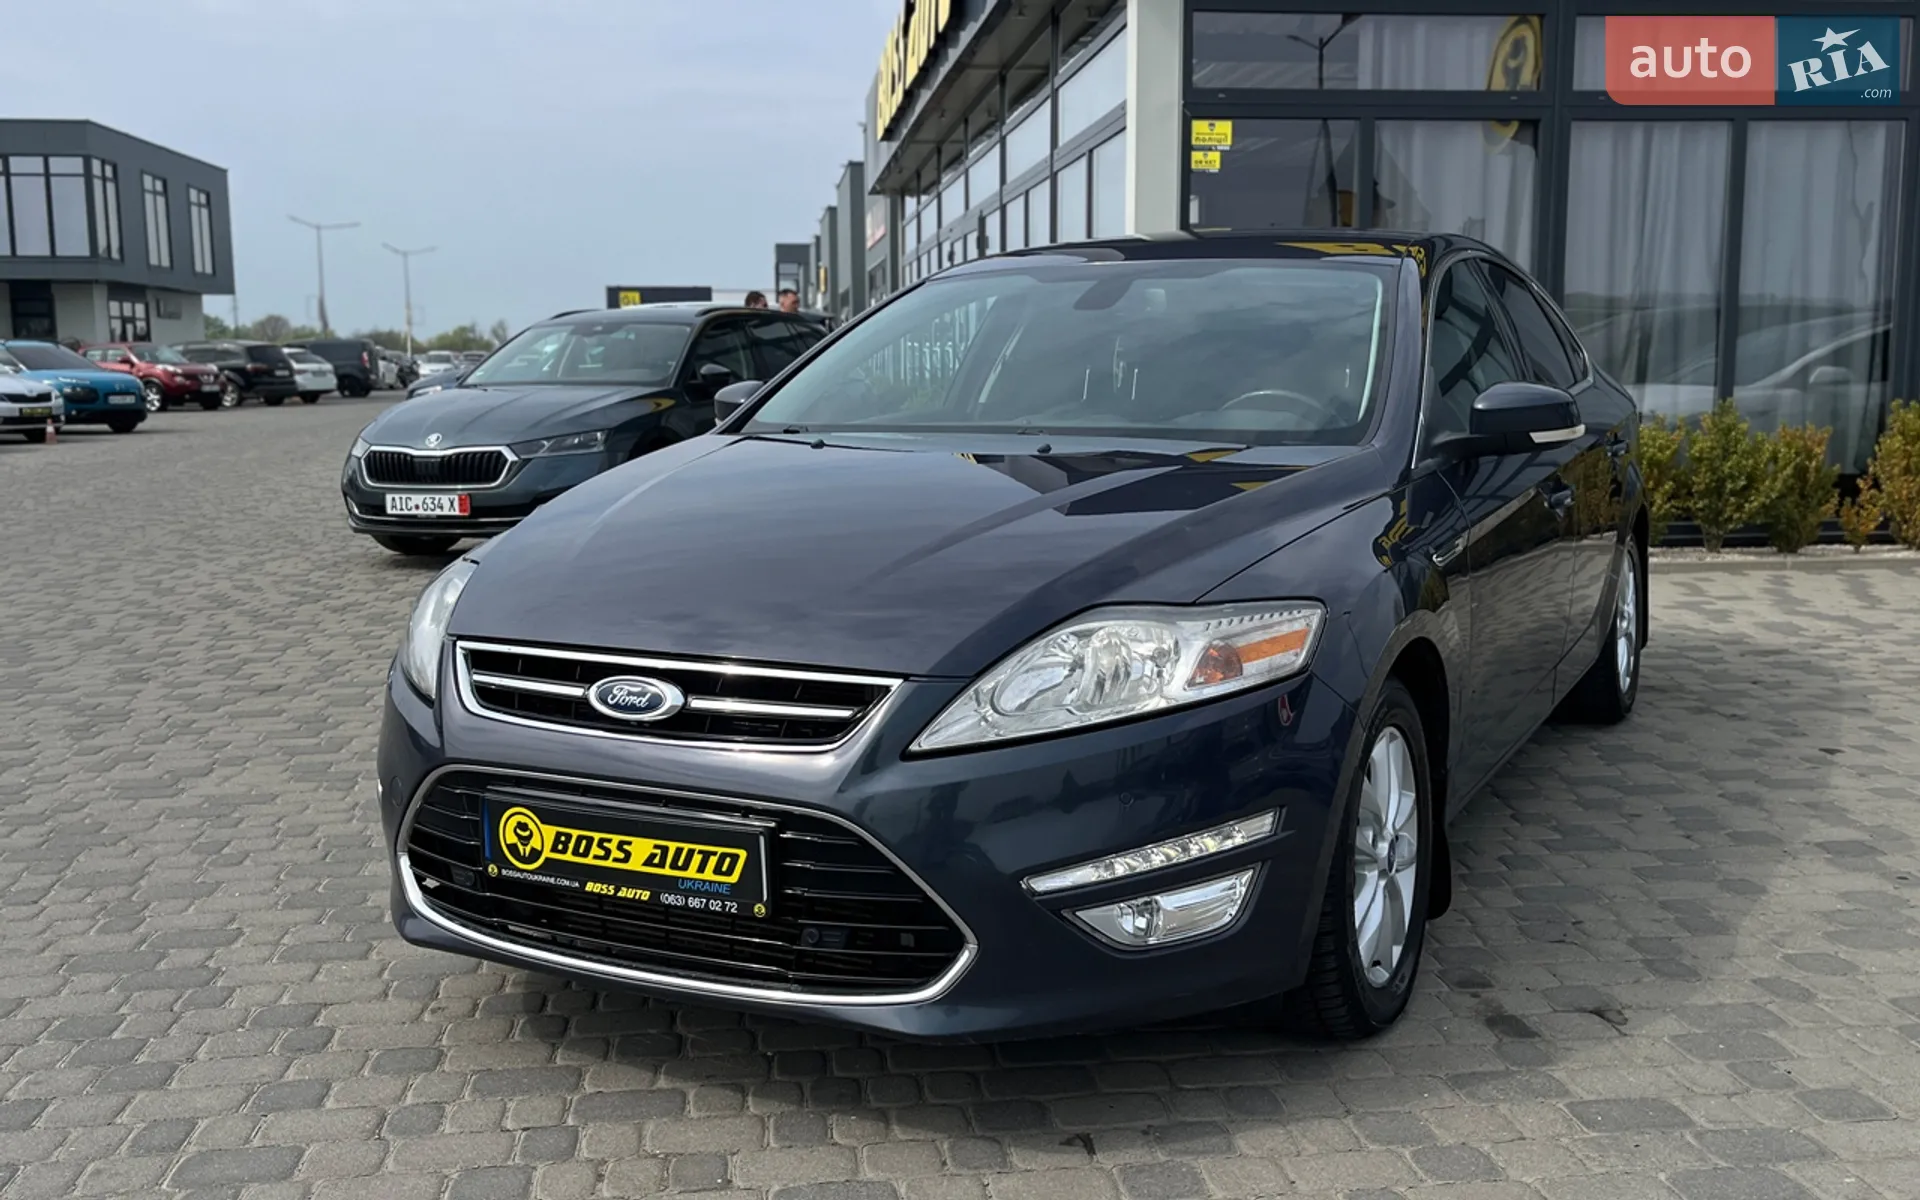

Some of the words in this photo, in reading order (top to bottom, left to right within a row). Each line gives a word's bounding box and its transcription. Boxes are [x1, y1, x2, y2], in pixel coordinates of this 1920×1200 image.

[421, 497, 444, 512] 634
[448, 497, 456, 512] X
[607, 685, 652, 707] Ford
[549, 830, 633, 864] BOSS
[641, 843, 741, 877] AUTO
[585, 881, 615, 895] BOSS
[617, 887, 651, 901] AUTO
[677, 878, 732, 895] UKRAINE
[660, 892, 685, 906] (063)
[687, 896, 706, 909] 667
[709, 900, 722, 911] 02
[724, 901, 738, 913] 72
